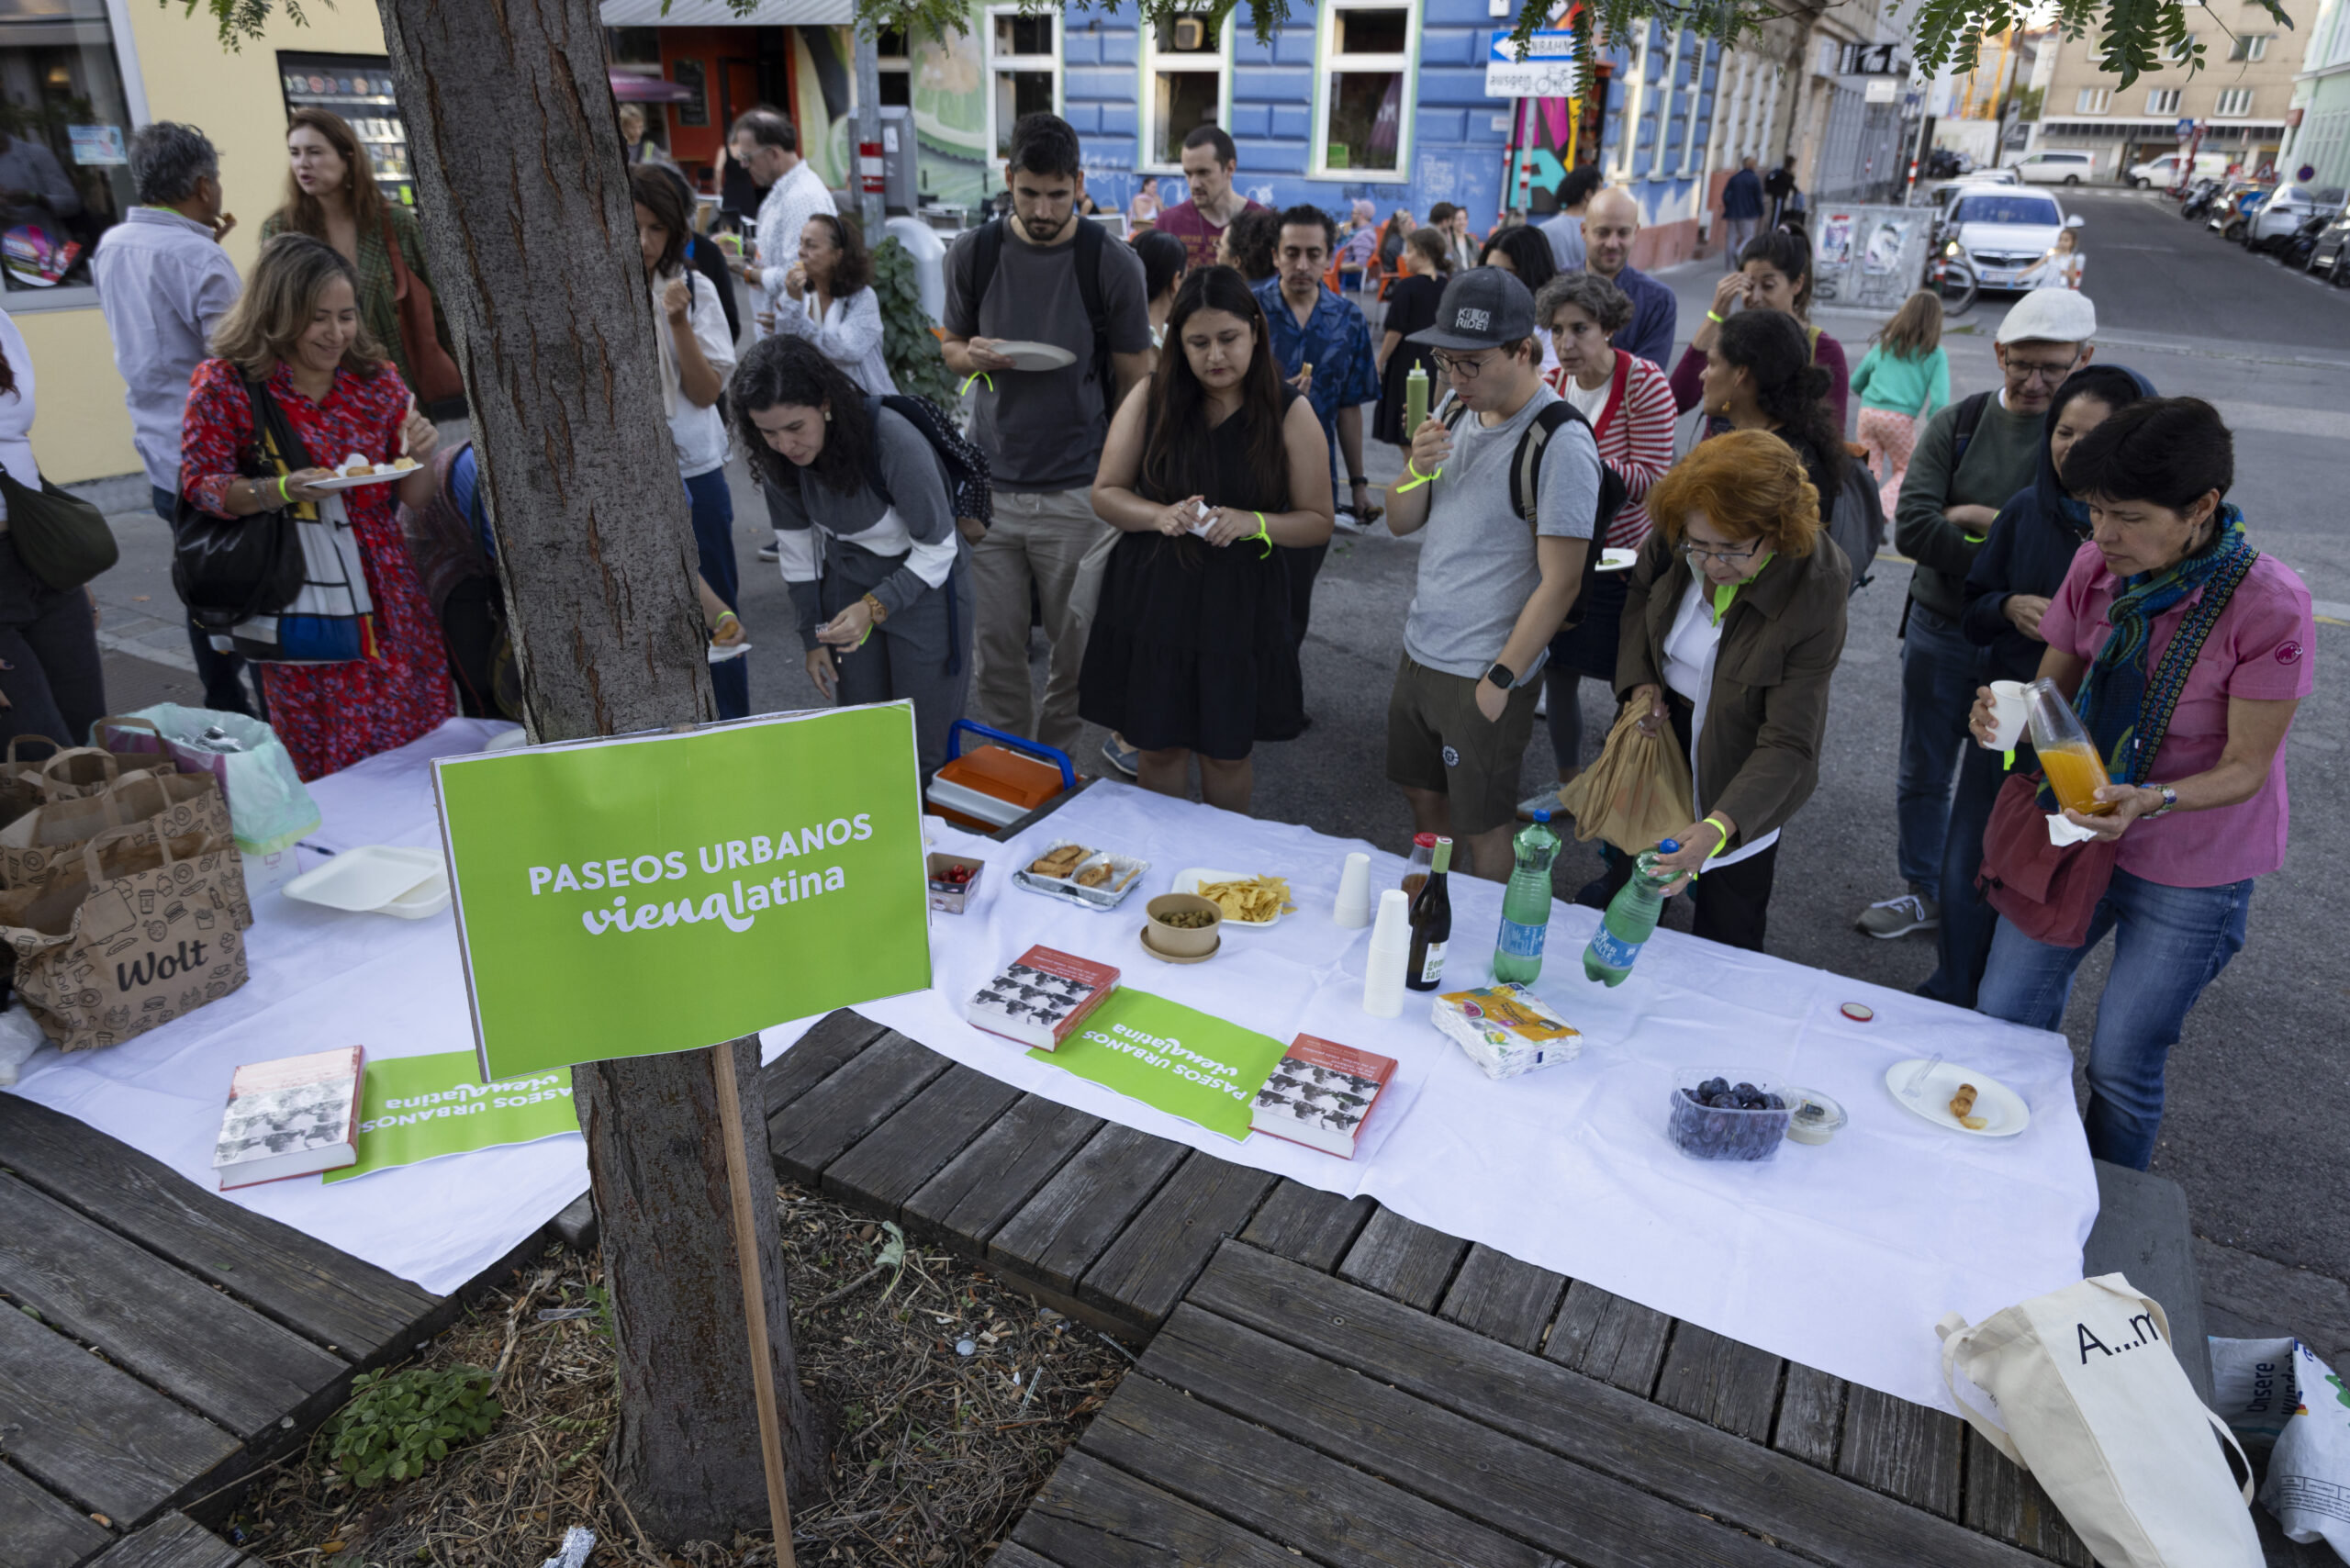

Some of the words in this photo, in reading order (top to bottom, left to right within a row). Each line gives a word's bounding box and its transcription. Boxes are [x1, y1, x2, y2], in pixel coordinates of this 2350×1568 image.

[529, 851, 688, 896] PASEOS
[699, 813, 873, 874] URBANOS
[117, 939, 209, 991] Wolt
[1081, 1030, 1170, 1070] URBANOS
[494, 1087, 573, 1108] ASEOS
[1172, 1064, 1248, 1101] PASEOS
[362, 1102, 486, 1133] URBANOS
[2245, 1362, 2275, 1413] Unsere
